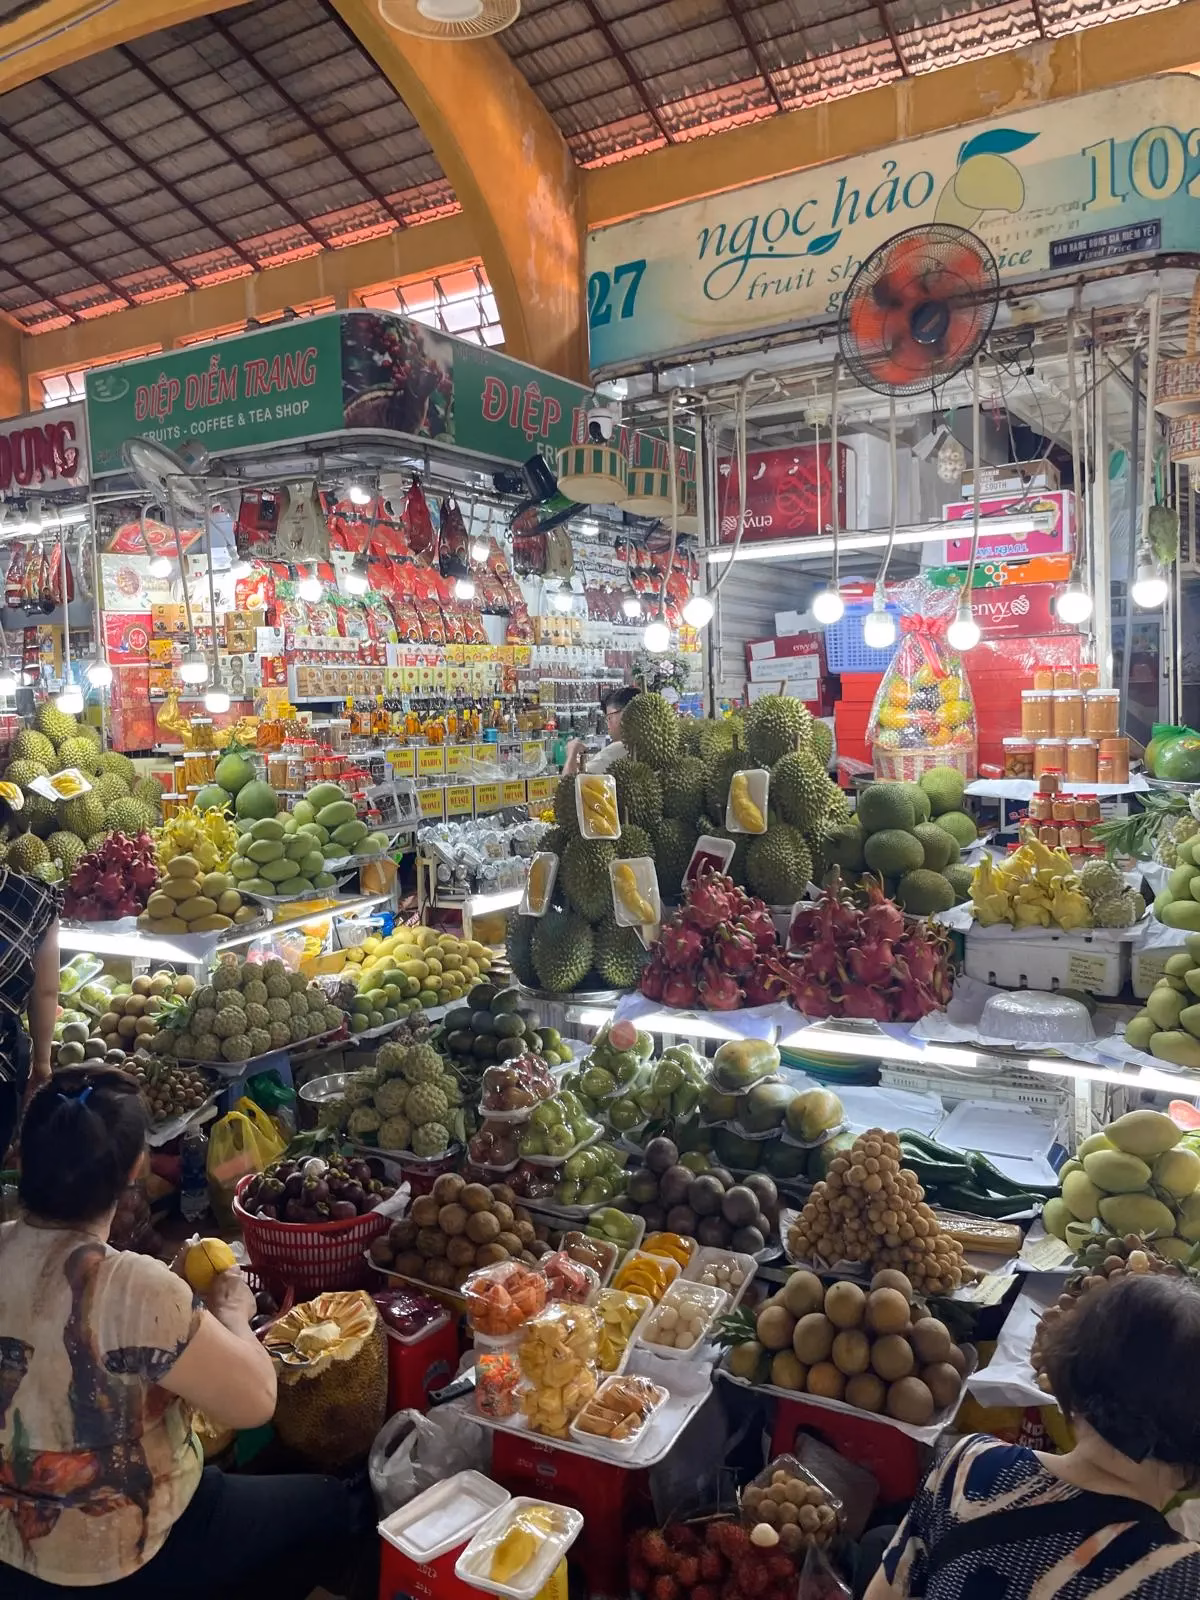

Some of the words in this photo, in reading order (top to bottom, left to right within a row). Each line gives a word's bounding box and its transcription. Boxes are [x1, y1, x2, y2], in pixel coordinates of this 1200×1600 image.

[697, 200, 818, 302] ngọc
[831, 160, 935, 229] hảo
[587, 259, 647, 330] 27
[745, 267, 816, 301] fruit
[135, 371, 181, 424] ĐIỆP
[244, 347, 318, 398] TRANG
[190, 414, 234, 435] COFFEE
[237, 412, 246, 426] &
[249, 407, 273, 423] TEA
[275, 400, 310, 418] SHOP
[481, 375, 562, 442] ĐIỆP
[971, 601, 1011, 623] envy
